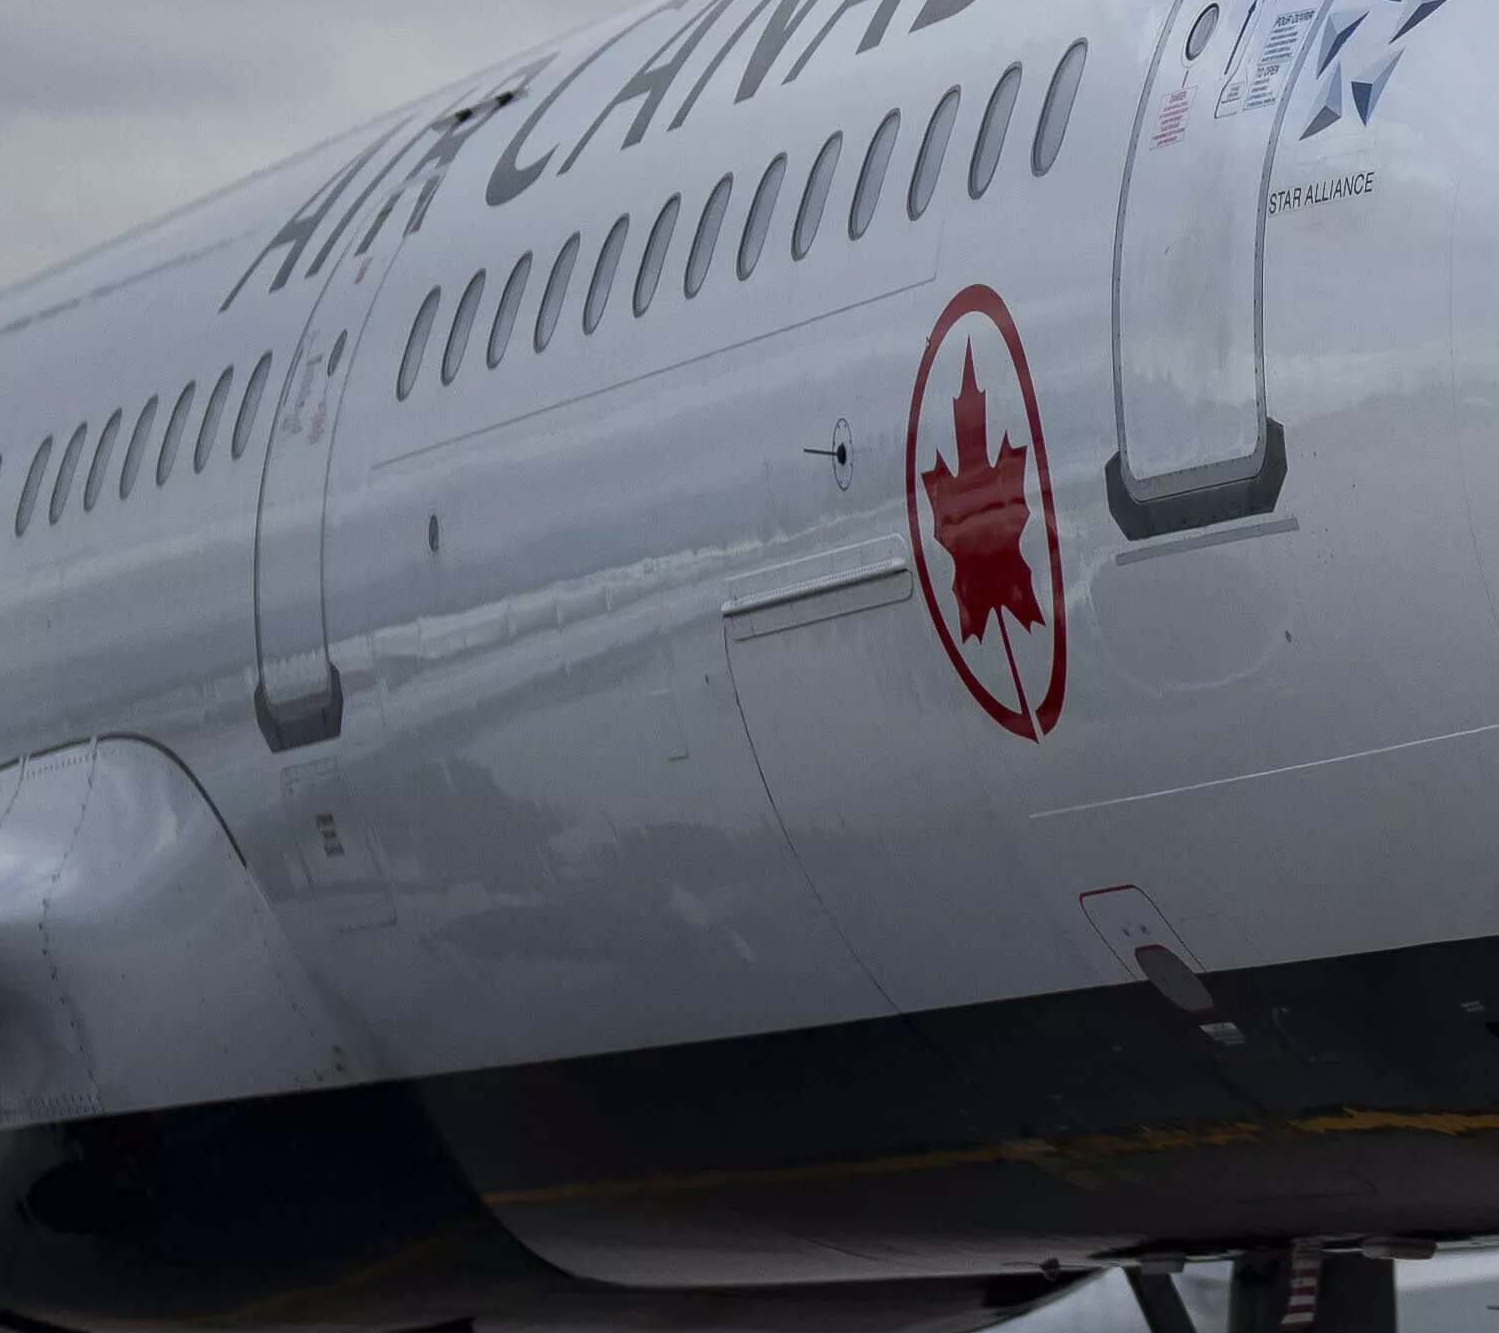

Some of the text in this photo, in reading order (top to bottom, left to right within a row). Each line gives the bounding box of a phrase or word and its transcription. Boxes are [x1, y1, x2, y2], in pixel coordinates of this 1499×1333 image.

[217, 51, 560, 316] AIR
[1268, 171, 1375, 214] STAR ALLIANCE
